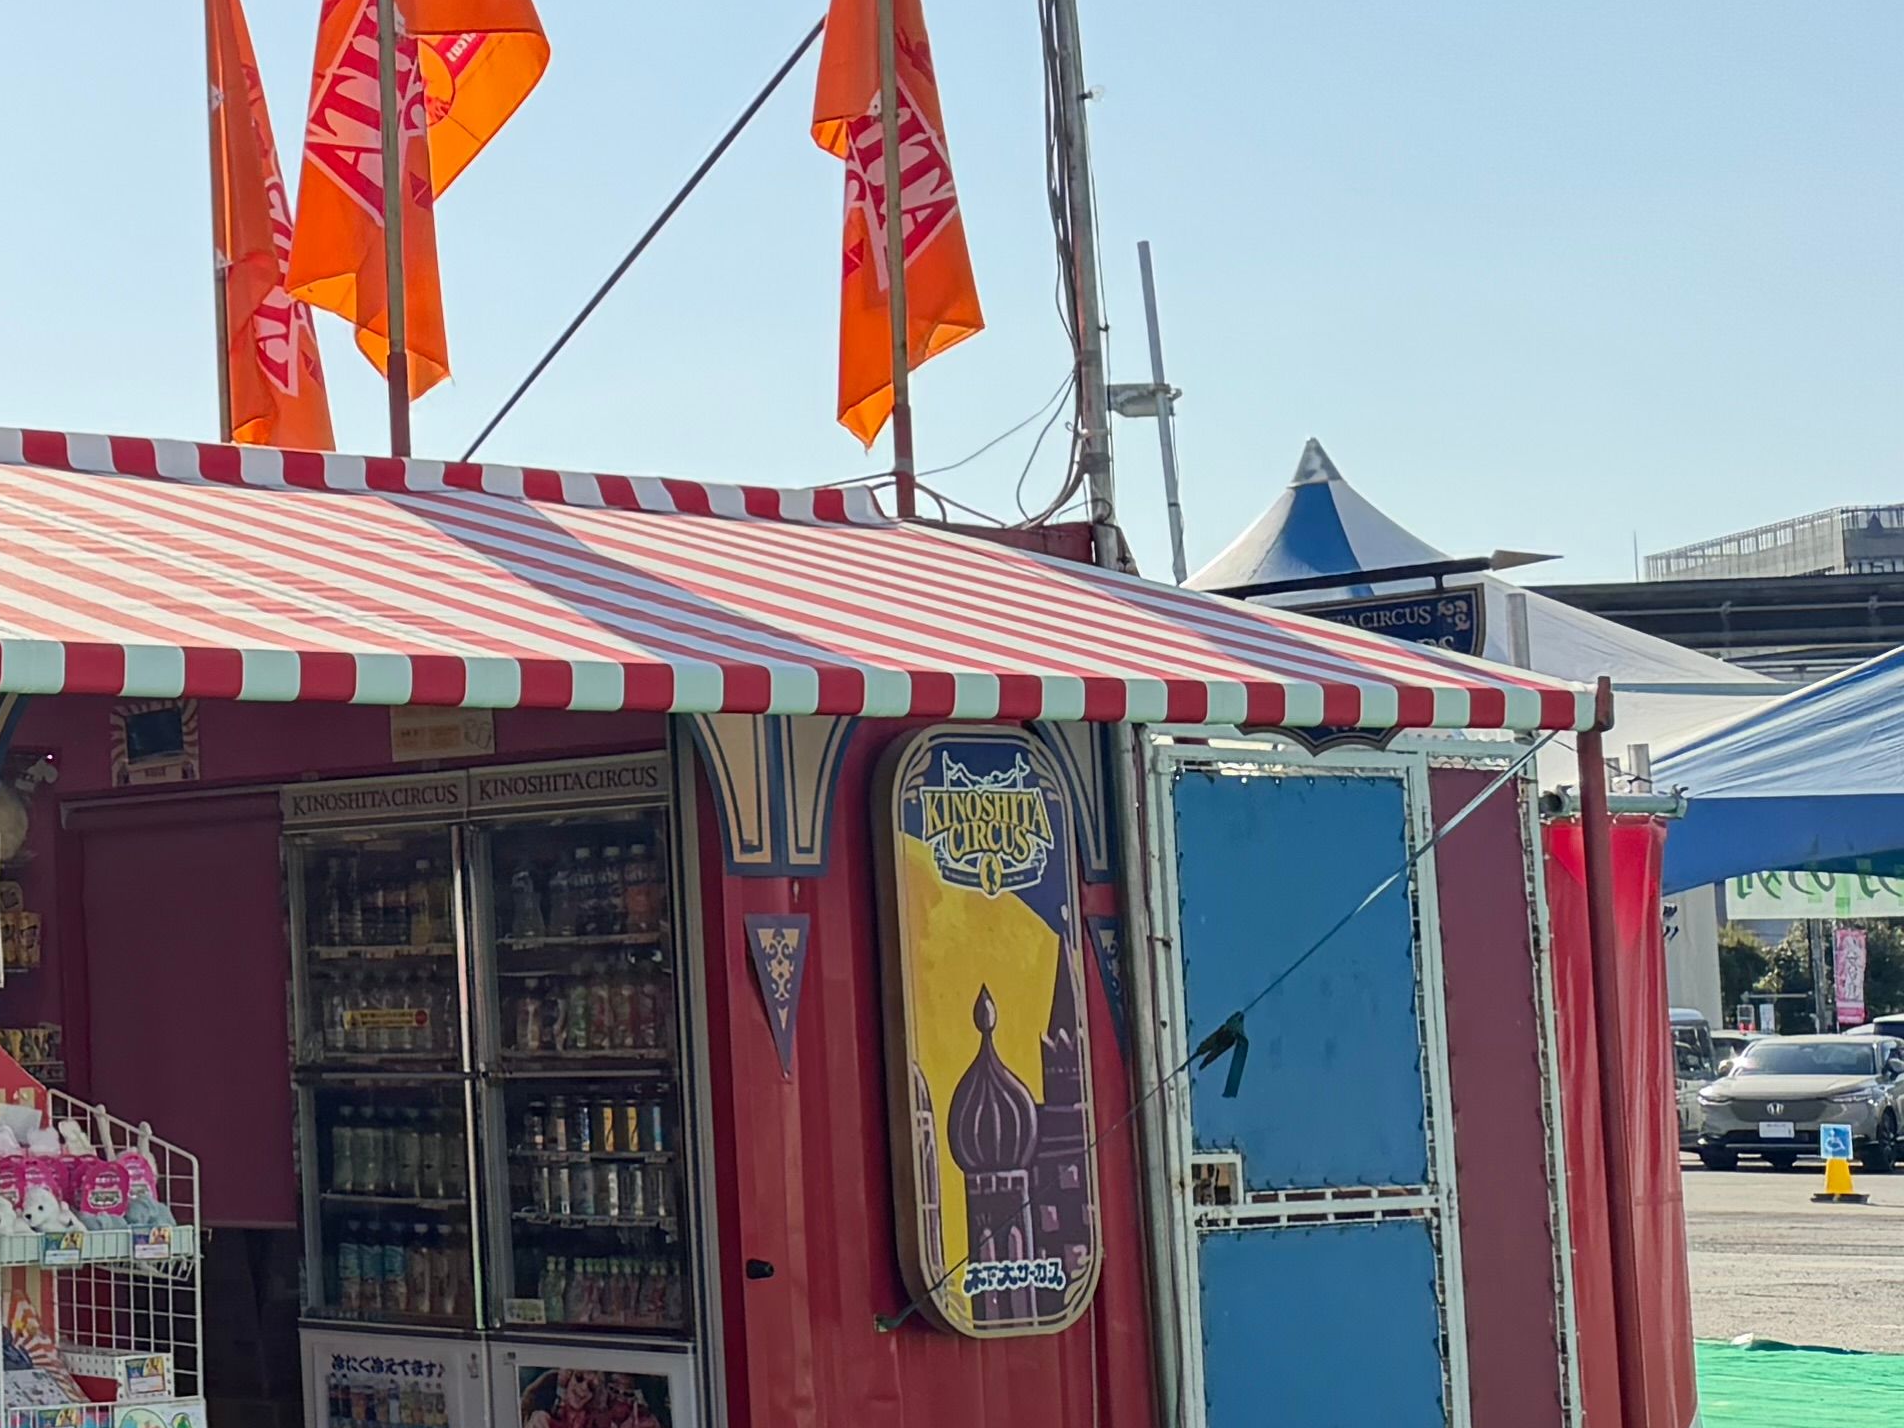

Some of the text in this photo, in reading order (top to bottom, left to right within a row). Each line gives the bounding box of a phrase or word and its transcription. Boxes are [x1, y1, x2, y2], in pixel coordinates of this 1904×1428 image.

[924, 792, 1052, 843] KINOSHITA
[948, 822, 1029, 862] CIRCUS
[964, 1262, 1064, 1293] 木下大サーカス
